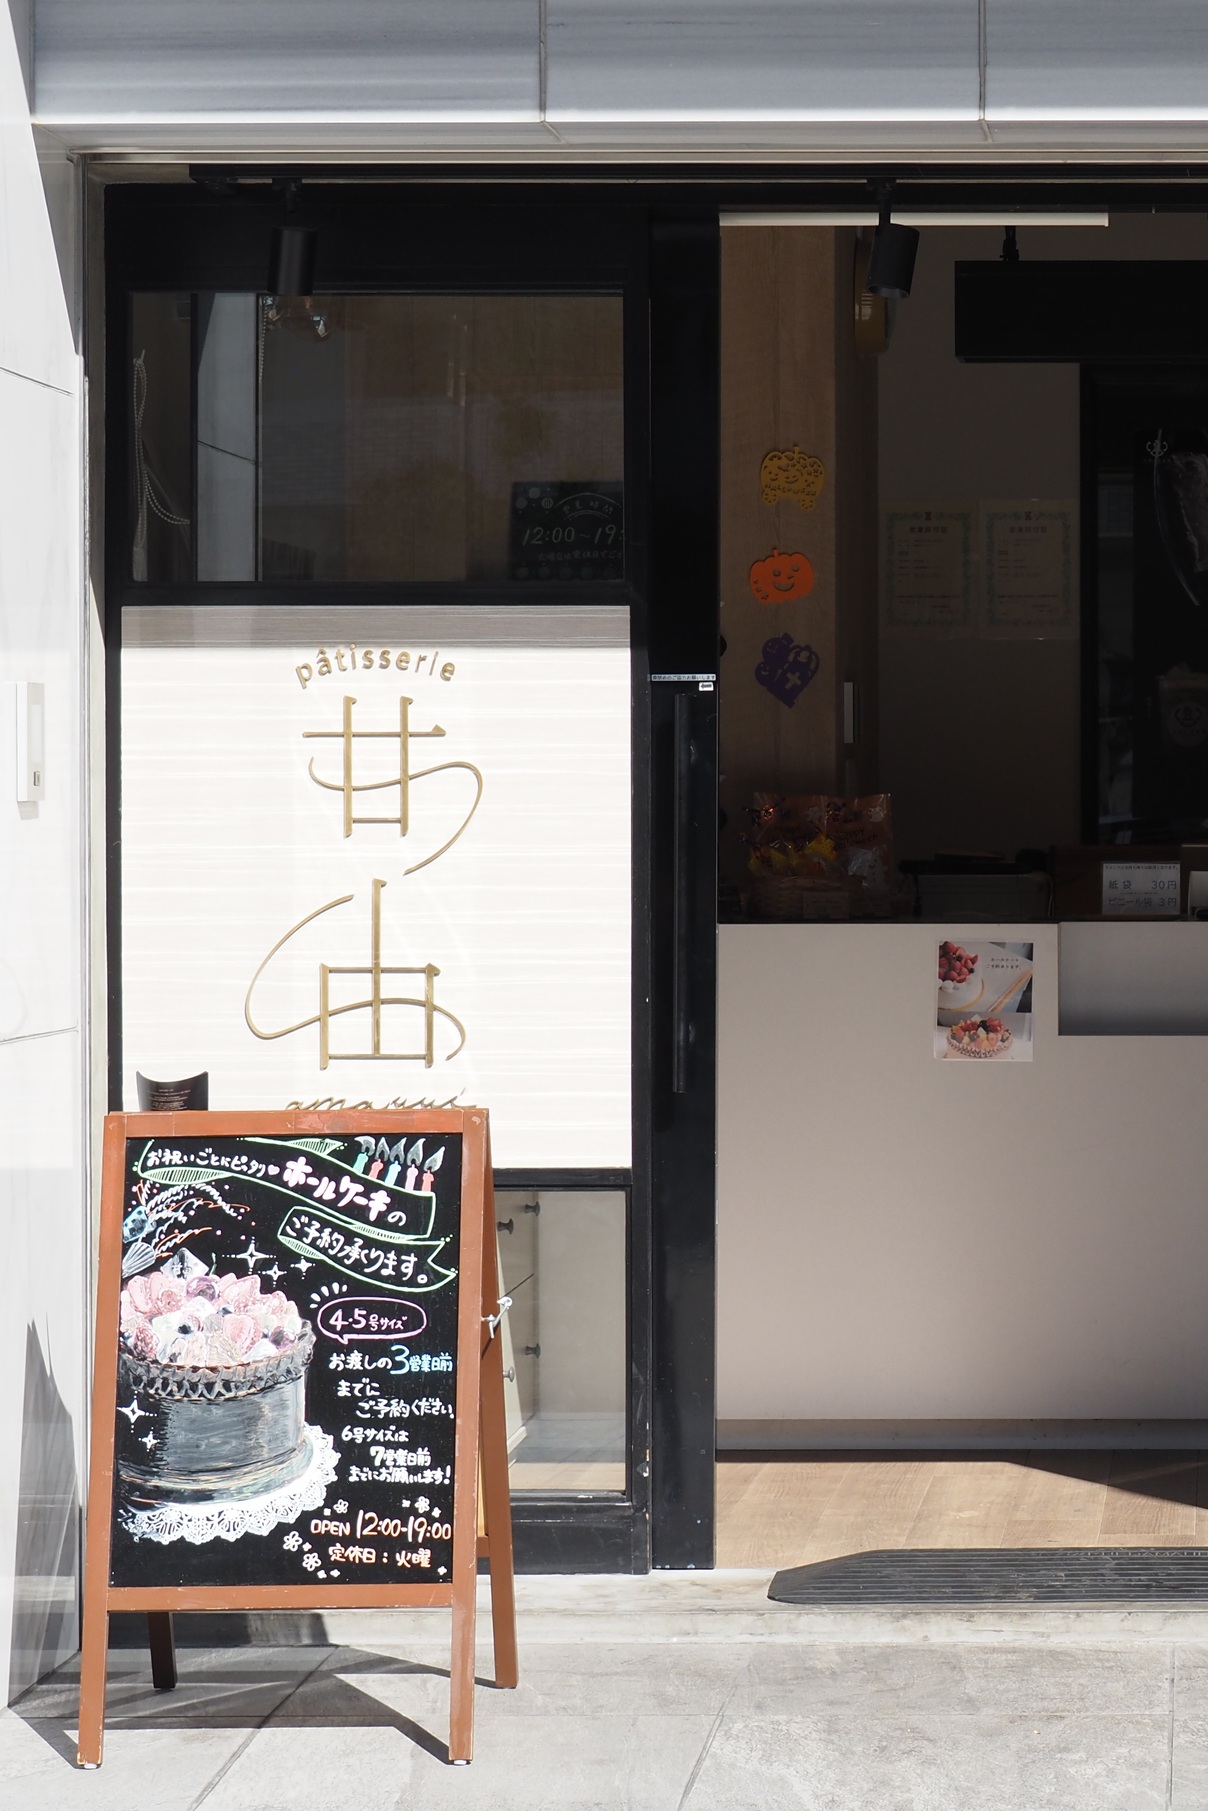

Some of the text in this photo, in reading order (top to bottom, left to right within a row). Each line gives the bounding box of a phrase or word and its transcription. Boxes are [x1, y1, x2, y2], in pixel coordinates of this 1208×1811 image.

[295, 643, 456, 689] pâtisserie
[1151, 880, 1177, 890] 30円
[1108, 897, 1177, 907] ビニール袋 3円
[146, 1148, 407, 1227] お祝いごとにピッタリ ホールケーキの
[285, 1214, 428, 1284] ご予約承ります。
[329, 1344, 454, 1375] お渡しの3営業日前
[337, 1378, 381, 1397] までに
[341, 1426, 409, 1443] 6号サイズは
[370, 1446, 432, 1467] 7営業日前
[310, 1510, 452, 1542] OPEN 12:00-19:00
